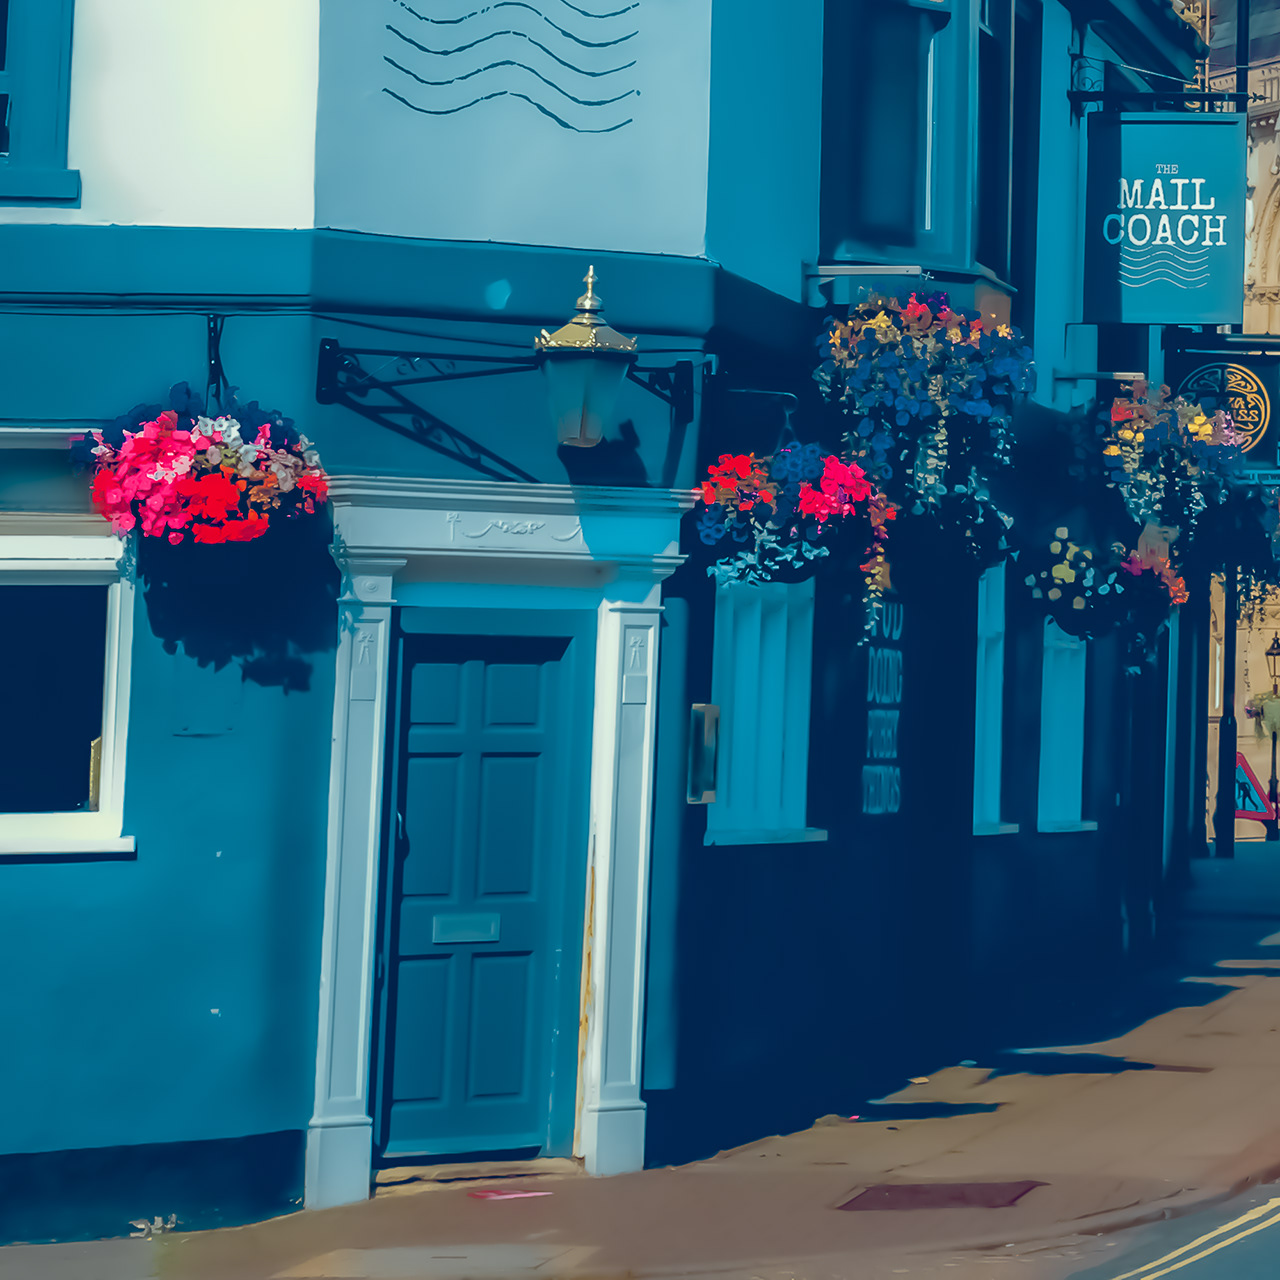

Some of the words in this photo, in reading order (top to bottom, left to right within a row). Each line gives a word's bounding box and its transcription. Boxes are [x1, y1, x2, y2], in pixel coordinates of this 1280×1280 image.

[1155, 163, 1179, 175] THE
[1117, 177, 1215, 210] MAIL
[1102, 213, 1228, 246] COACH
